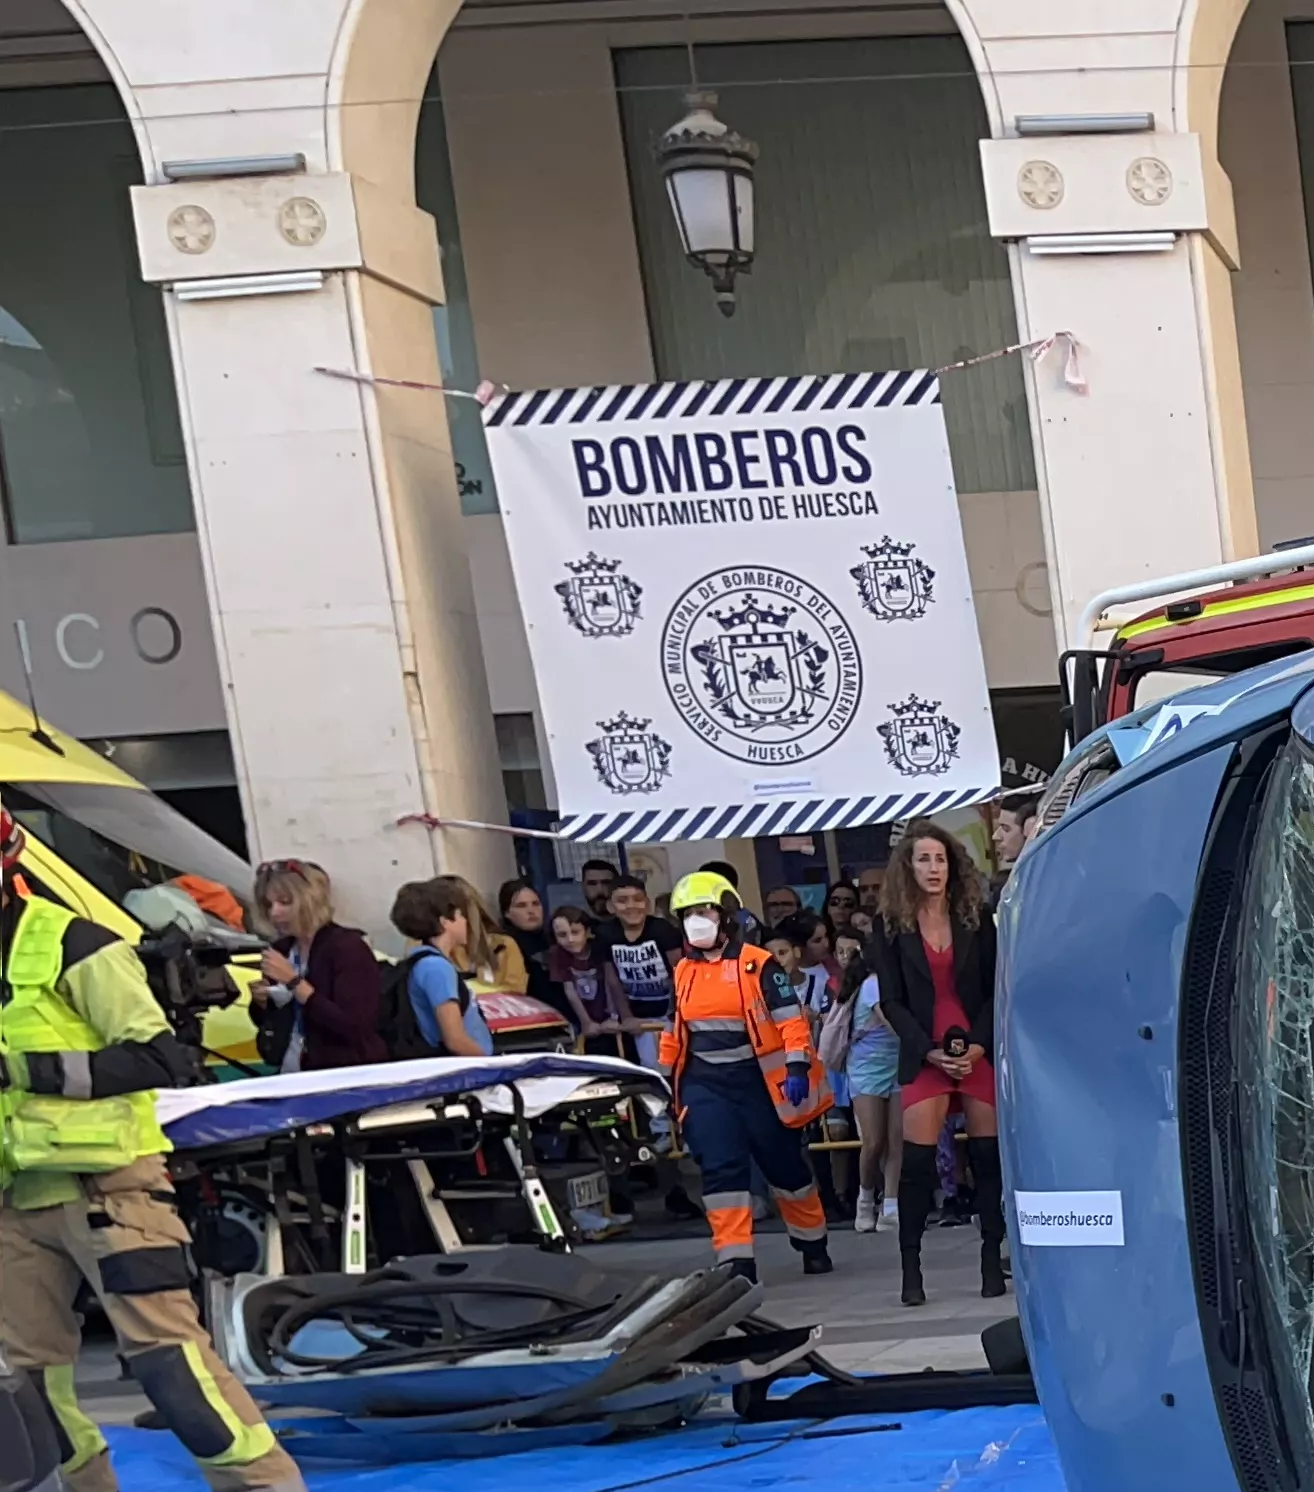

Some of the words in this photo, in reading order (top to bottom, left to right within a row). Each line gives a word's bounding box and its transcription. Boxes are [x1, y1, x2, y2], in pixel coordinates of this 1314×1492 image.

[571, 424, 873, 498] BOMBEROS
[587, 497, 753, 531] AYUNTAMIENTO
[760, 495, 788, 521] DE
[791, 490, 879, 519] HUESCA
[697, 580, 718, 601] DE
[721, 571, 804, 598] BOMBEROS
[806, 594, 833, 622] DEL
[666, 597, 700, 676] MUNICIPAL
[827, 623, 858, 732] AYUNTAMIENTO
[672, 682, 723, 743] SERVICIO
[747, 743, 804, 761] HUESCA
